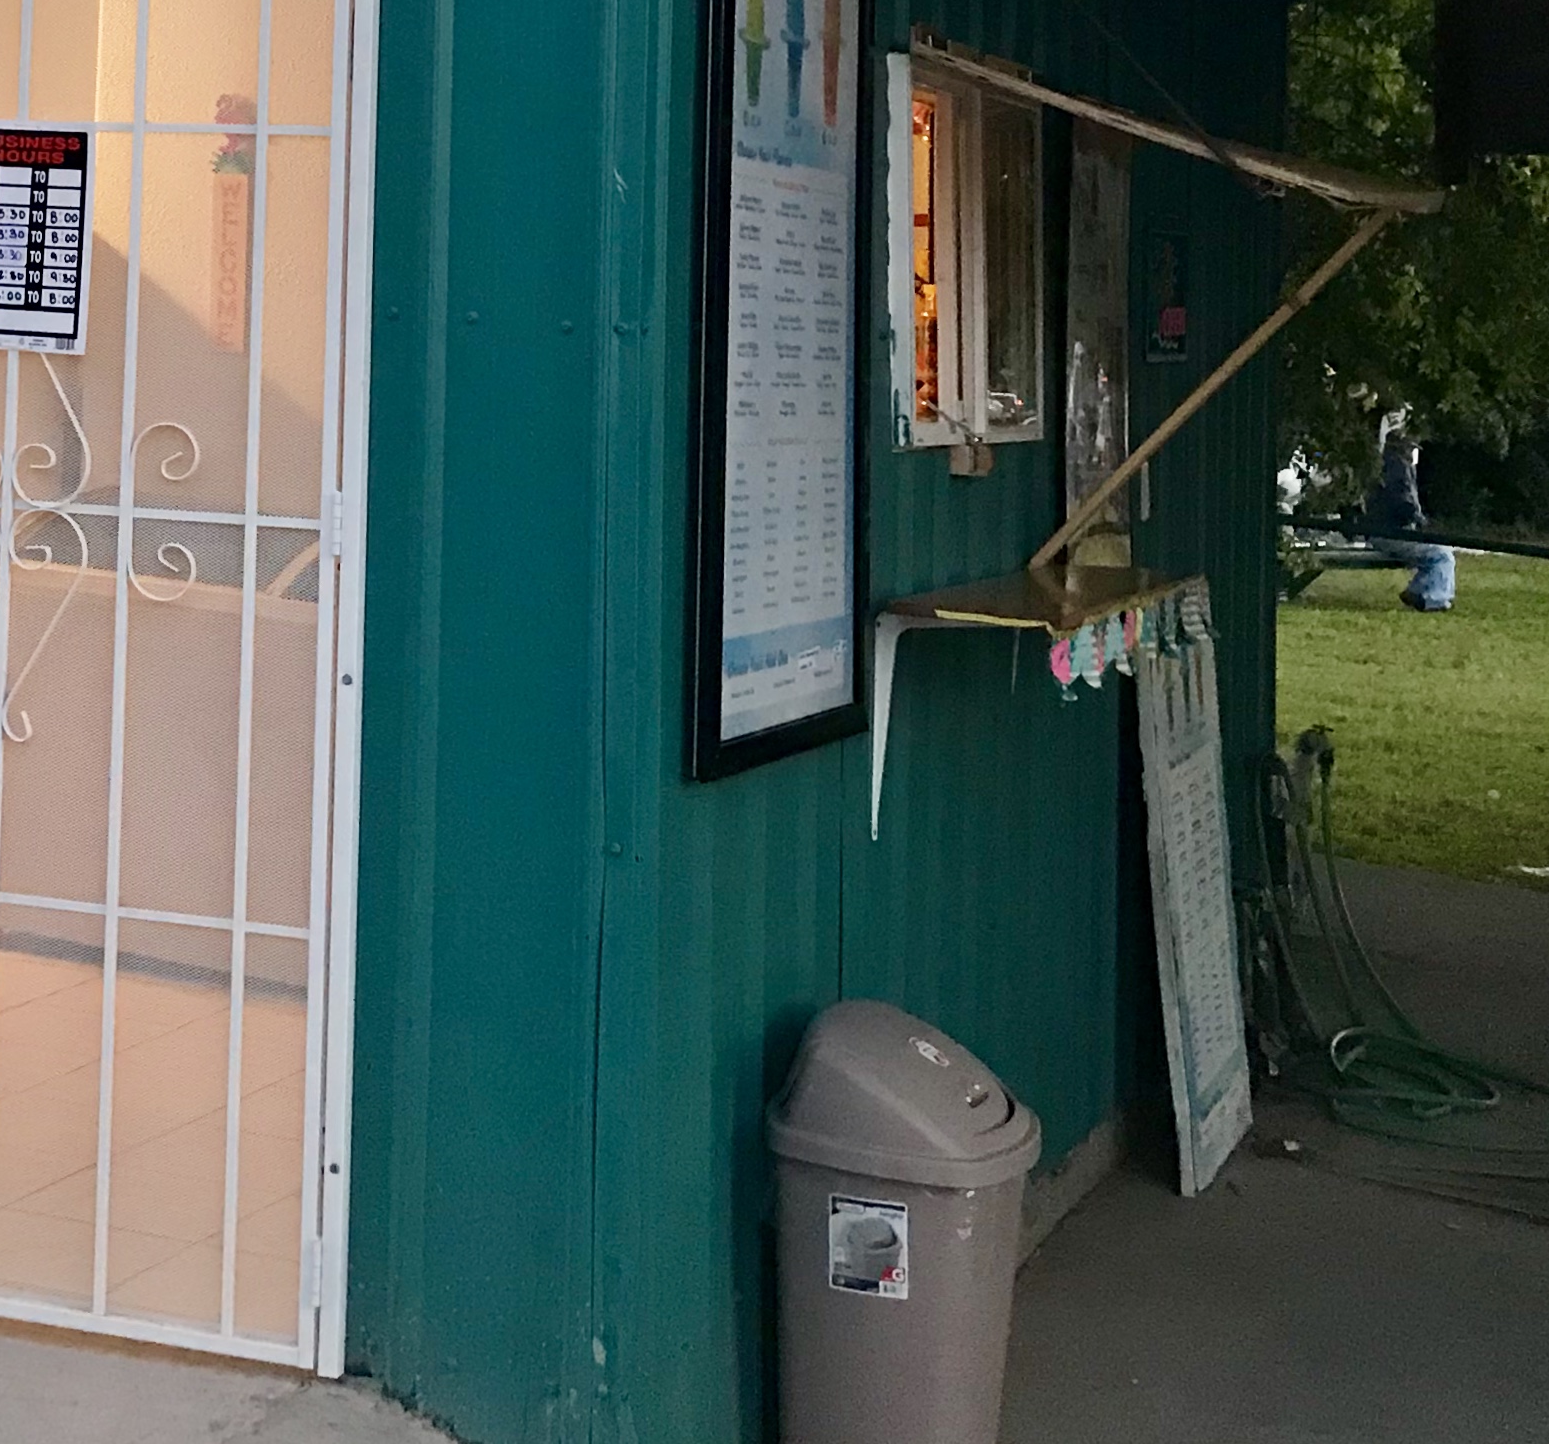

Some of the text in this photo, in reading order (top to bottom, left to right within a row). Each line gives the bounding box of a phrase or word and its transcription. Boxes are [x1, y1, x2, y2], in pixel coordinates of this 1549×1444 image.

[34, 171, 46, 183] TO
[33, 191, 45, 203] TO
[32, 211, 44, 223] TO
[31, 231, 43, 243] TO
[30, 251, 42, 263] TO
[29, 271, 41, 283] TO
[28, 291, 40, 303] TO
